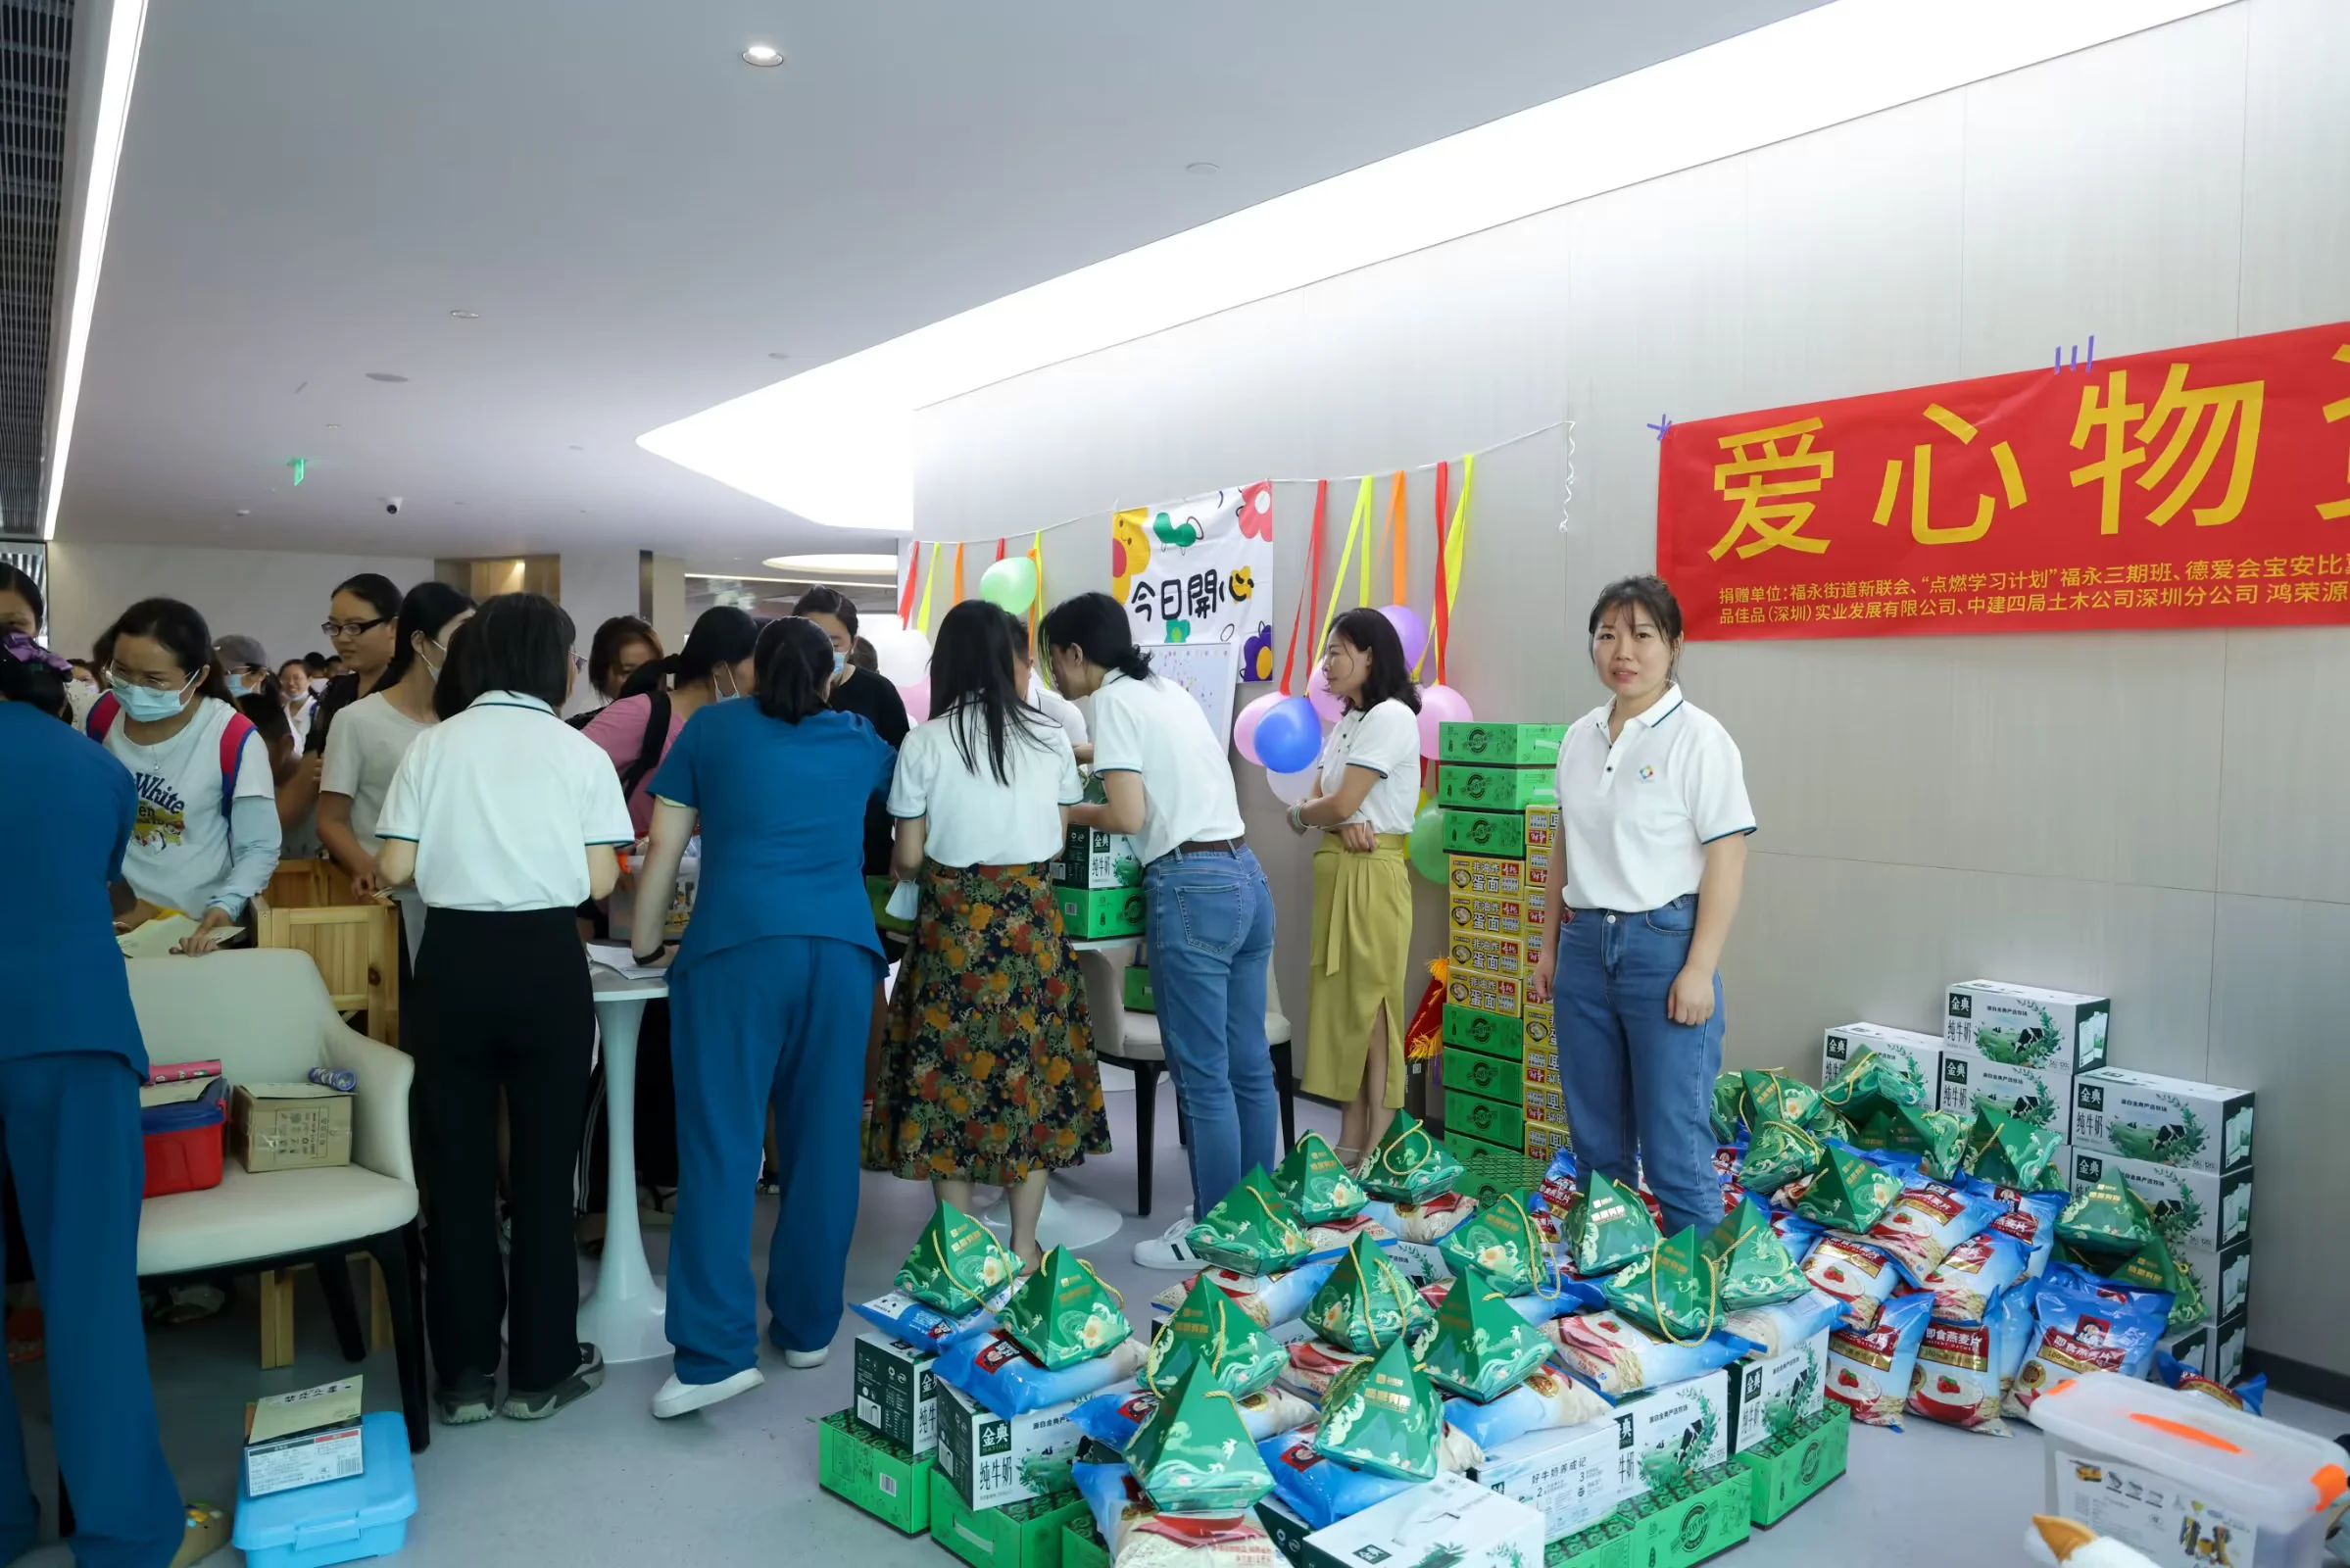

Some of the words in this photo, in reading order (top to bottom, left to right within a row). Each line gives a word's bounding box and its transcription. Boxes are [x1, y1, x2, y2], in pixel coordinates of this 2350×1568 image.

[1707, 343, 2350, 563] 爱心物
[1719, 553, 2350, 605] 捐赠单位：福永街道新联会、“点燃学习计划”福永三期班、德爱会宝安比
[1131, 568, 1254, 622] 今日開心
[2265, 579, 2349, 604] 鸿荣源
[135, 771, 185, 814] White
[1472, 873, 1499, 893] 蛋面
[1472, 912, 1499, 932] 蛋面
[1472, 951, 1499, 970] 蛋面
[1469, 989, 1496, 1008] 蛋面
[1950, 996, 1971, 1011] 金典
[1947, 1020, 1972, 1044] 纯牛奶
[1828, 1039, 1846, 1054] 金典
[1946, 1061, 1966, 1078] 金典
[1943, 1085, 1968, 1109] 纯牛奶
[2080, 1087, 2102, 1106] 金典
[2076, 1110, 2104, 1139] 纯牛奶
[2079, 1158, 2101, 1177] 金典
[981, 1422, 1009, 1447] 金典
[979, 1456, 1012, 1491] 纯牛奶
[1618, 1450, 1635, 1484] 牛奶
